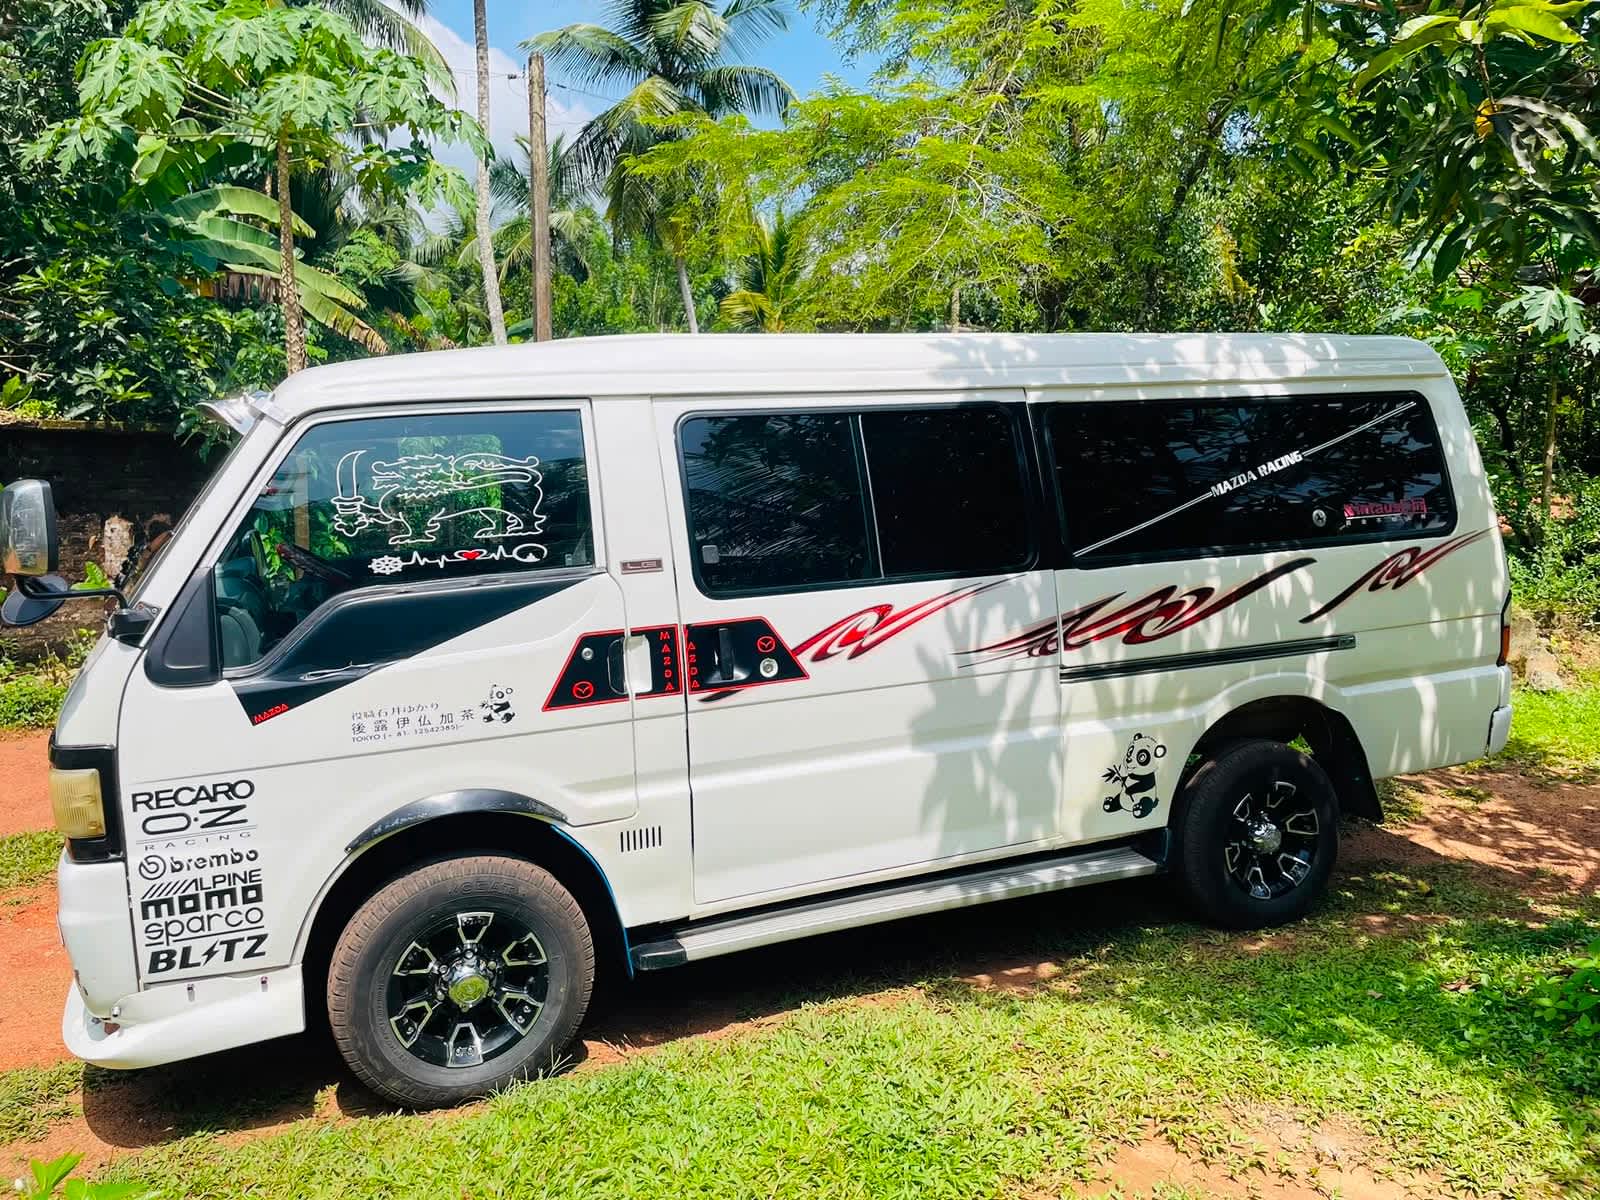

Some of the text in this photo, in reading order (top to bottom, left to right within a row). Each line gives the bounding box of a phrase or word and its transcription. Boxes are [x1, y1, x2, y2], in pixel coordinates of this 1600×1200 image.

[1210, 450, 1303, 497] MAZDA RACING
[660, 631, 674, 691] MAZDA
[254, 703, 289, 724] MAZDA
[351, 733, 381, 744] TOKYO
[131, 779, 255, 812] RECARO
[144, 831, 252, 851] RACING
[170, 848, 259, 873] brembo
[181, 868, 263, 894] ALPINE
[144, 907, 264, 946] sparco
